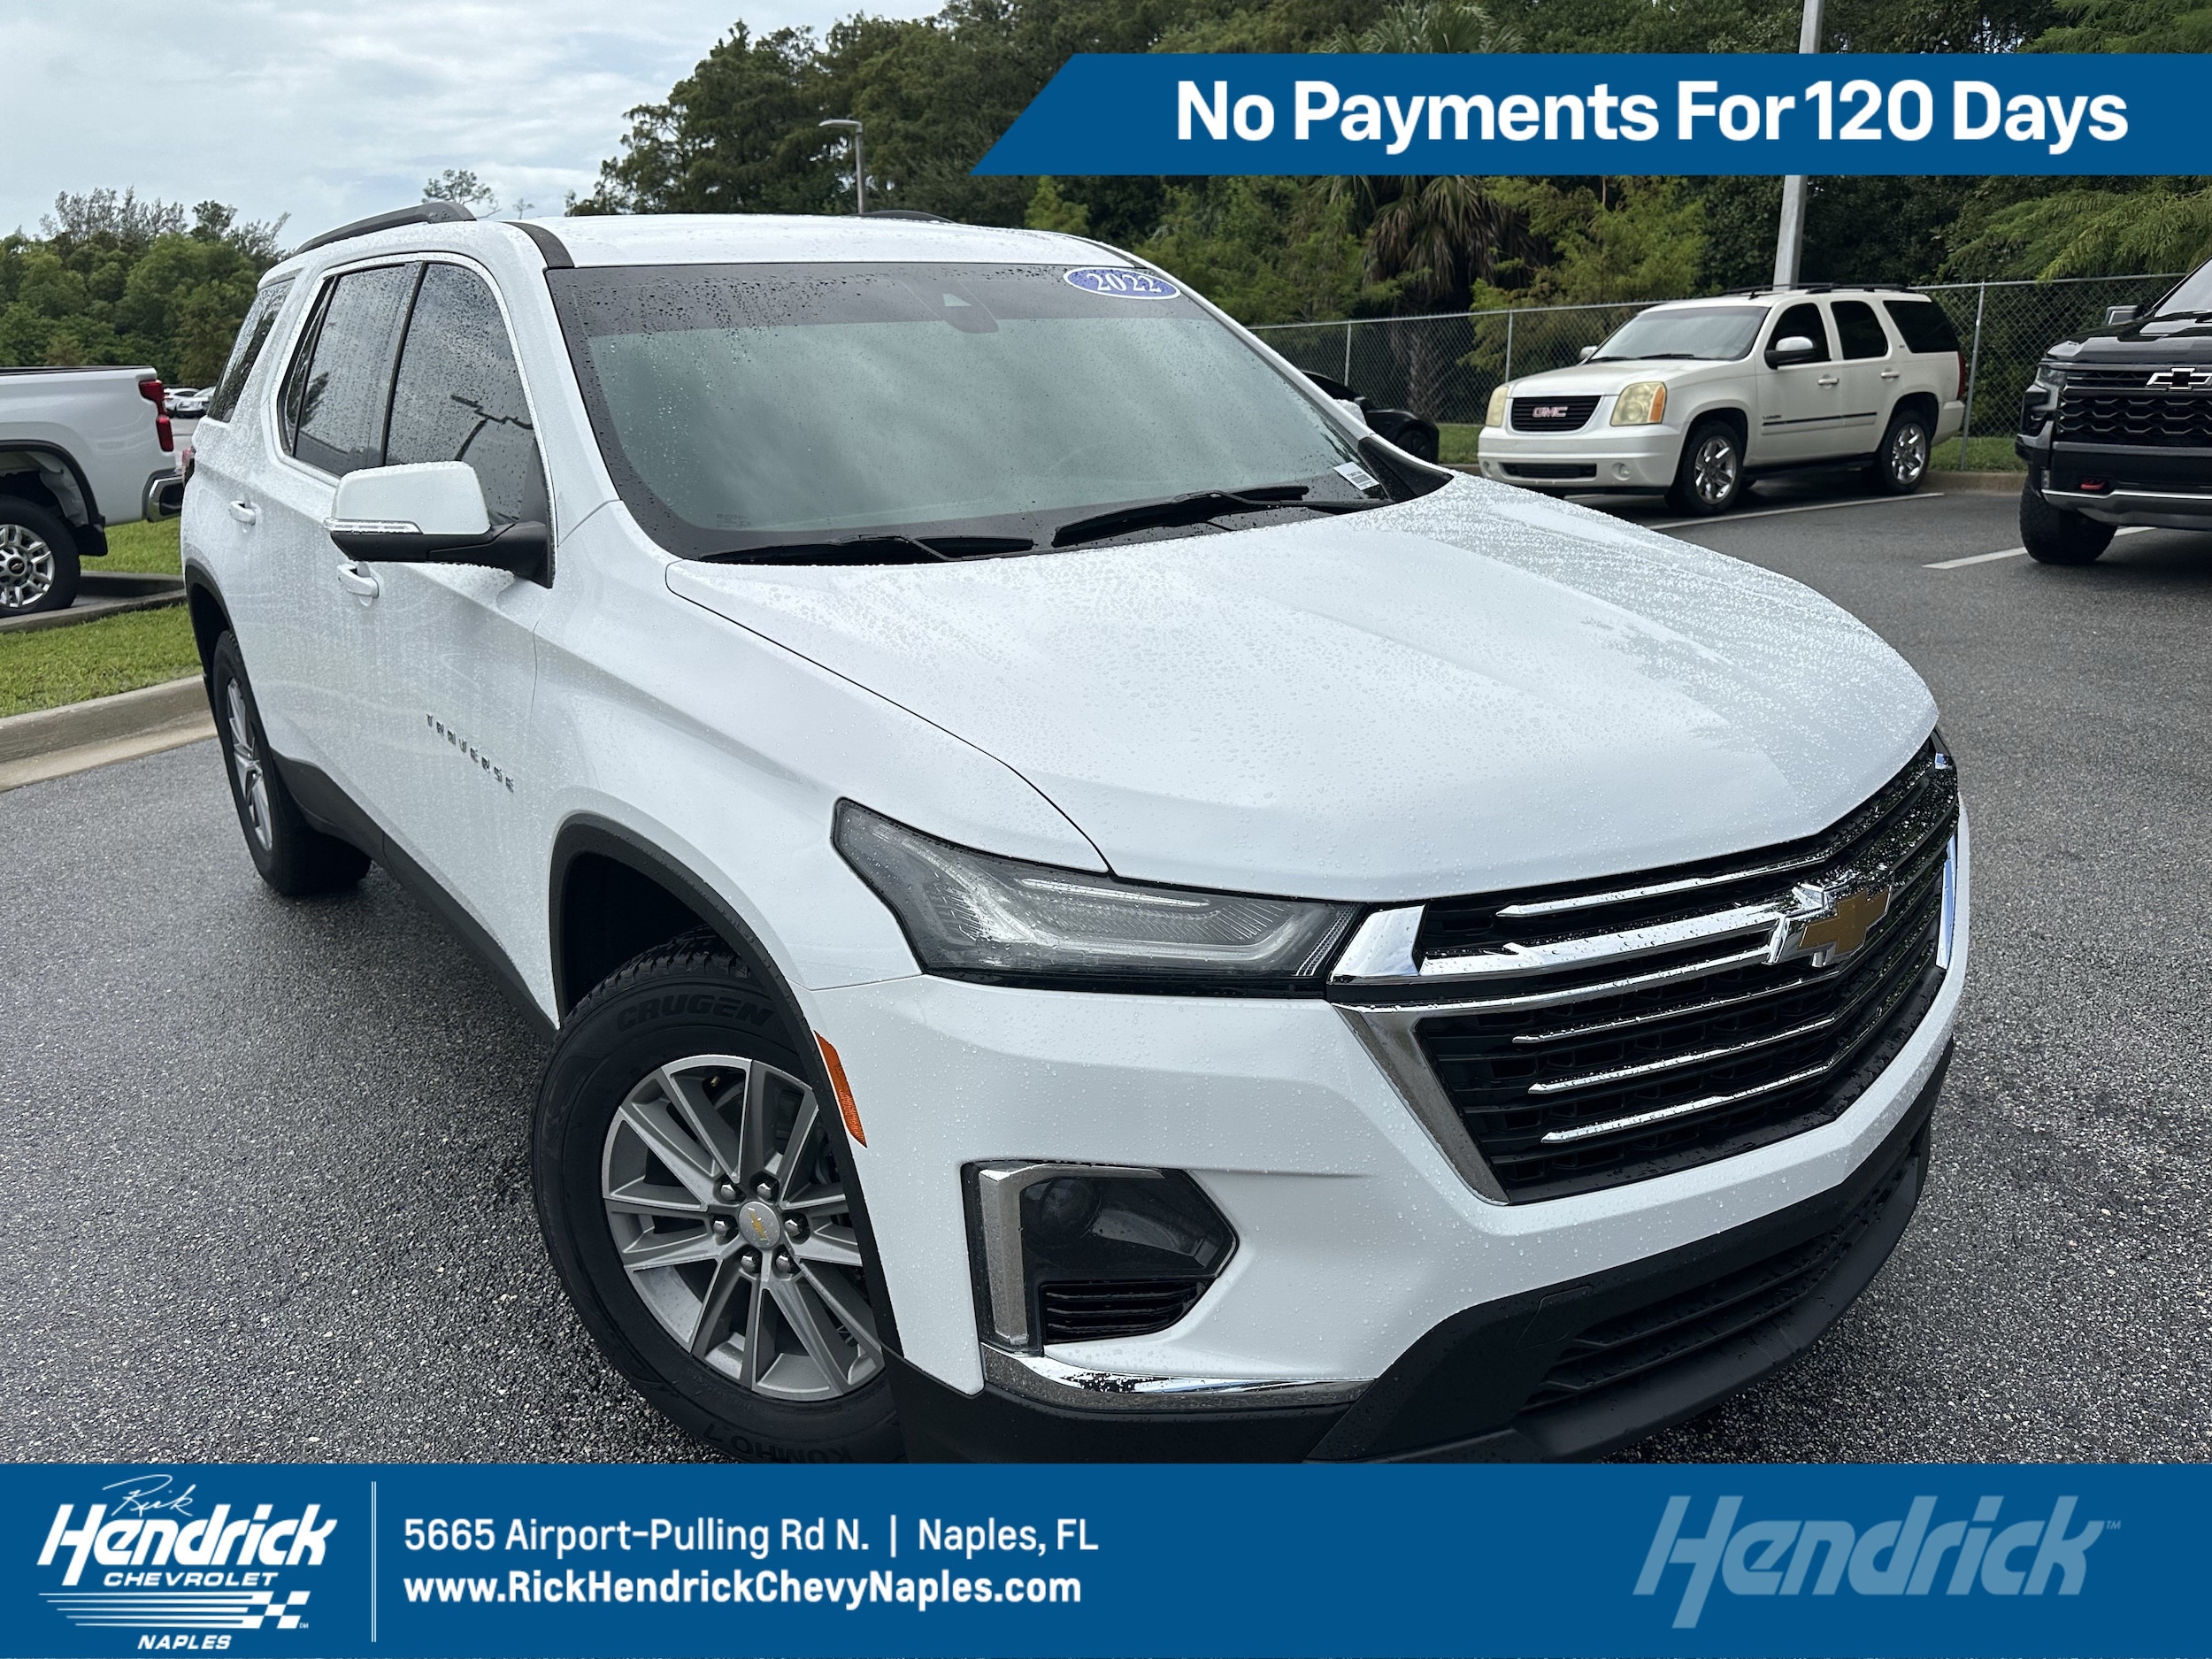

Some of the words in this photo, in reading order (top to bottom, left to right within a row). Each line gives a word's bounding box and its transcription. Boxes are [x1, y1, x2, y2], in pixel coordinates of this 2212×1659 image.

[1086, 273, 1163, 294] 2022
[1532, 406, 1569, 419] GMC
[426, 713, 515, 794] TRAVERSE
[618, 994, 776, 1033] CRUGEN
